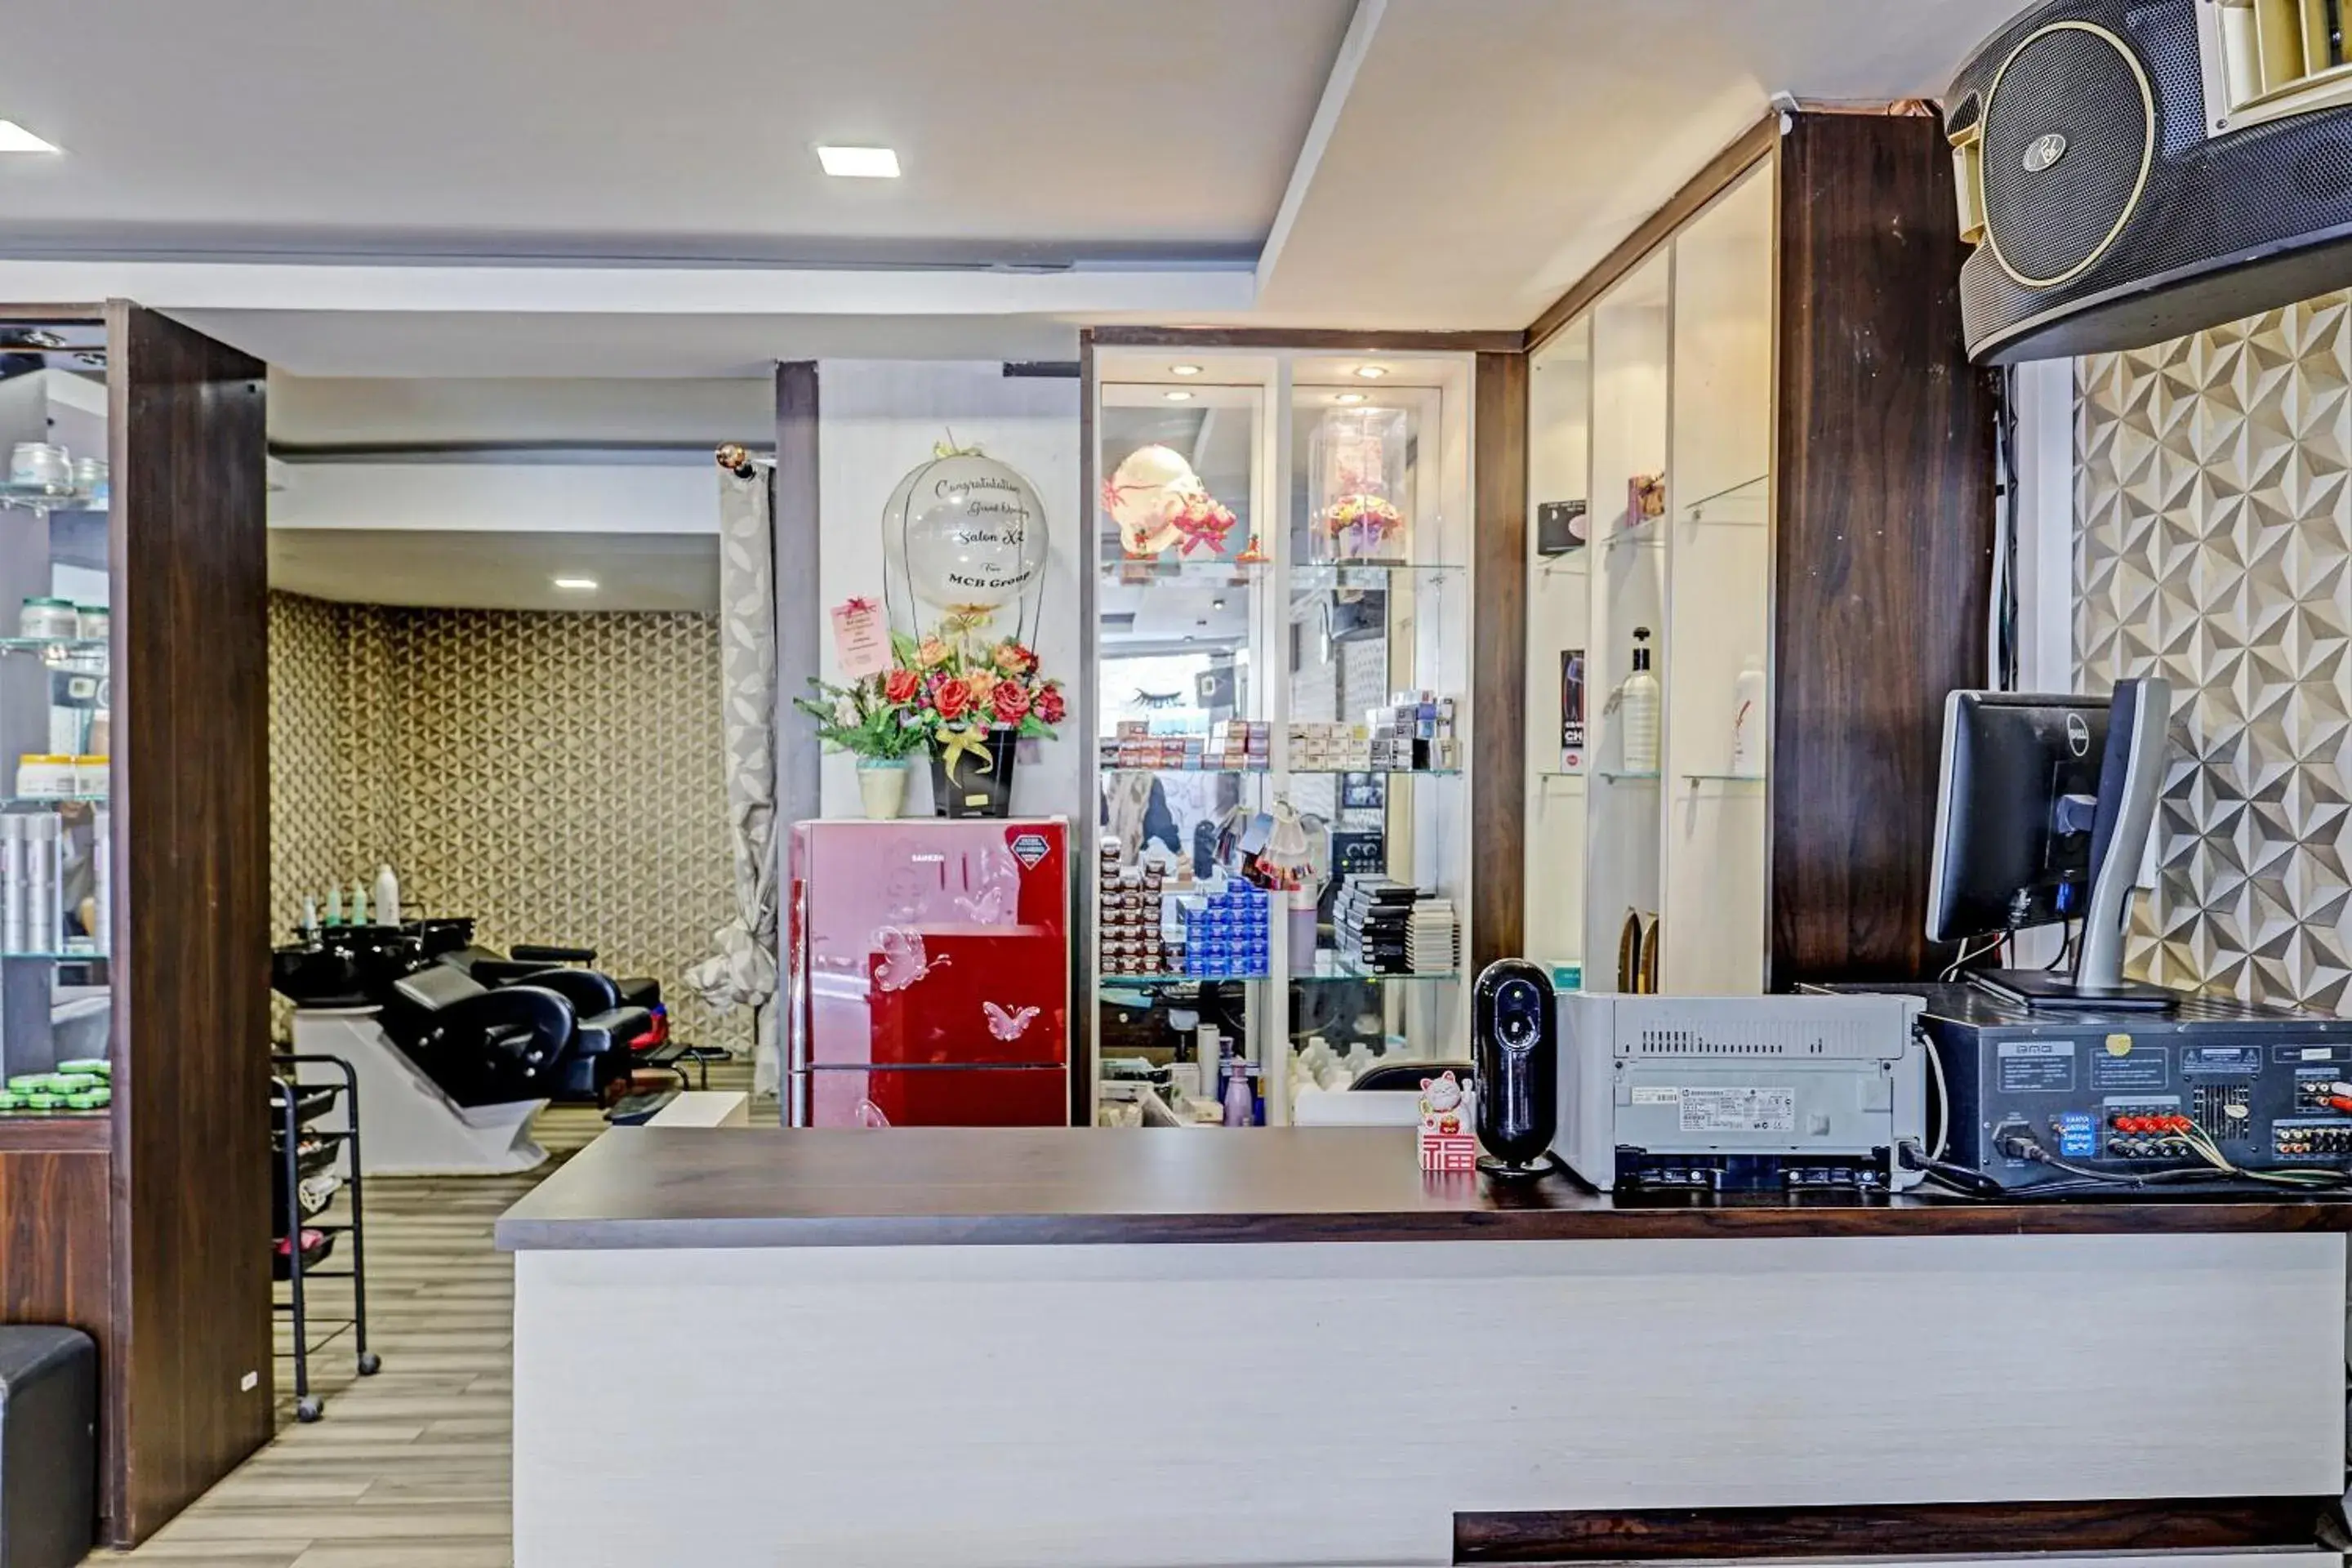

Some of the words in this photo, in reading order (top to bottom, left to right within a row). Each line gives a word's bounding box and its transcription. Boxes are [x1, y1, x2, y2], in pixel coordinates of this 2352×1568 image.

[959, 530, 998, 545] Salon
[948, 572, 986, 588] MCB
[989, 570, 1031, 589] Group
[2069, 728, 2087, 739] DELL
[1423, 1134, 1475, 1169] 福
